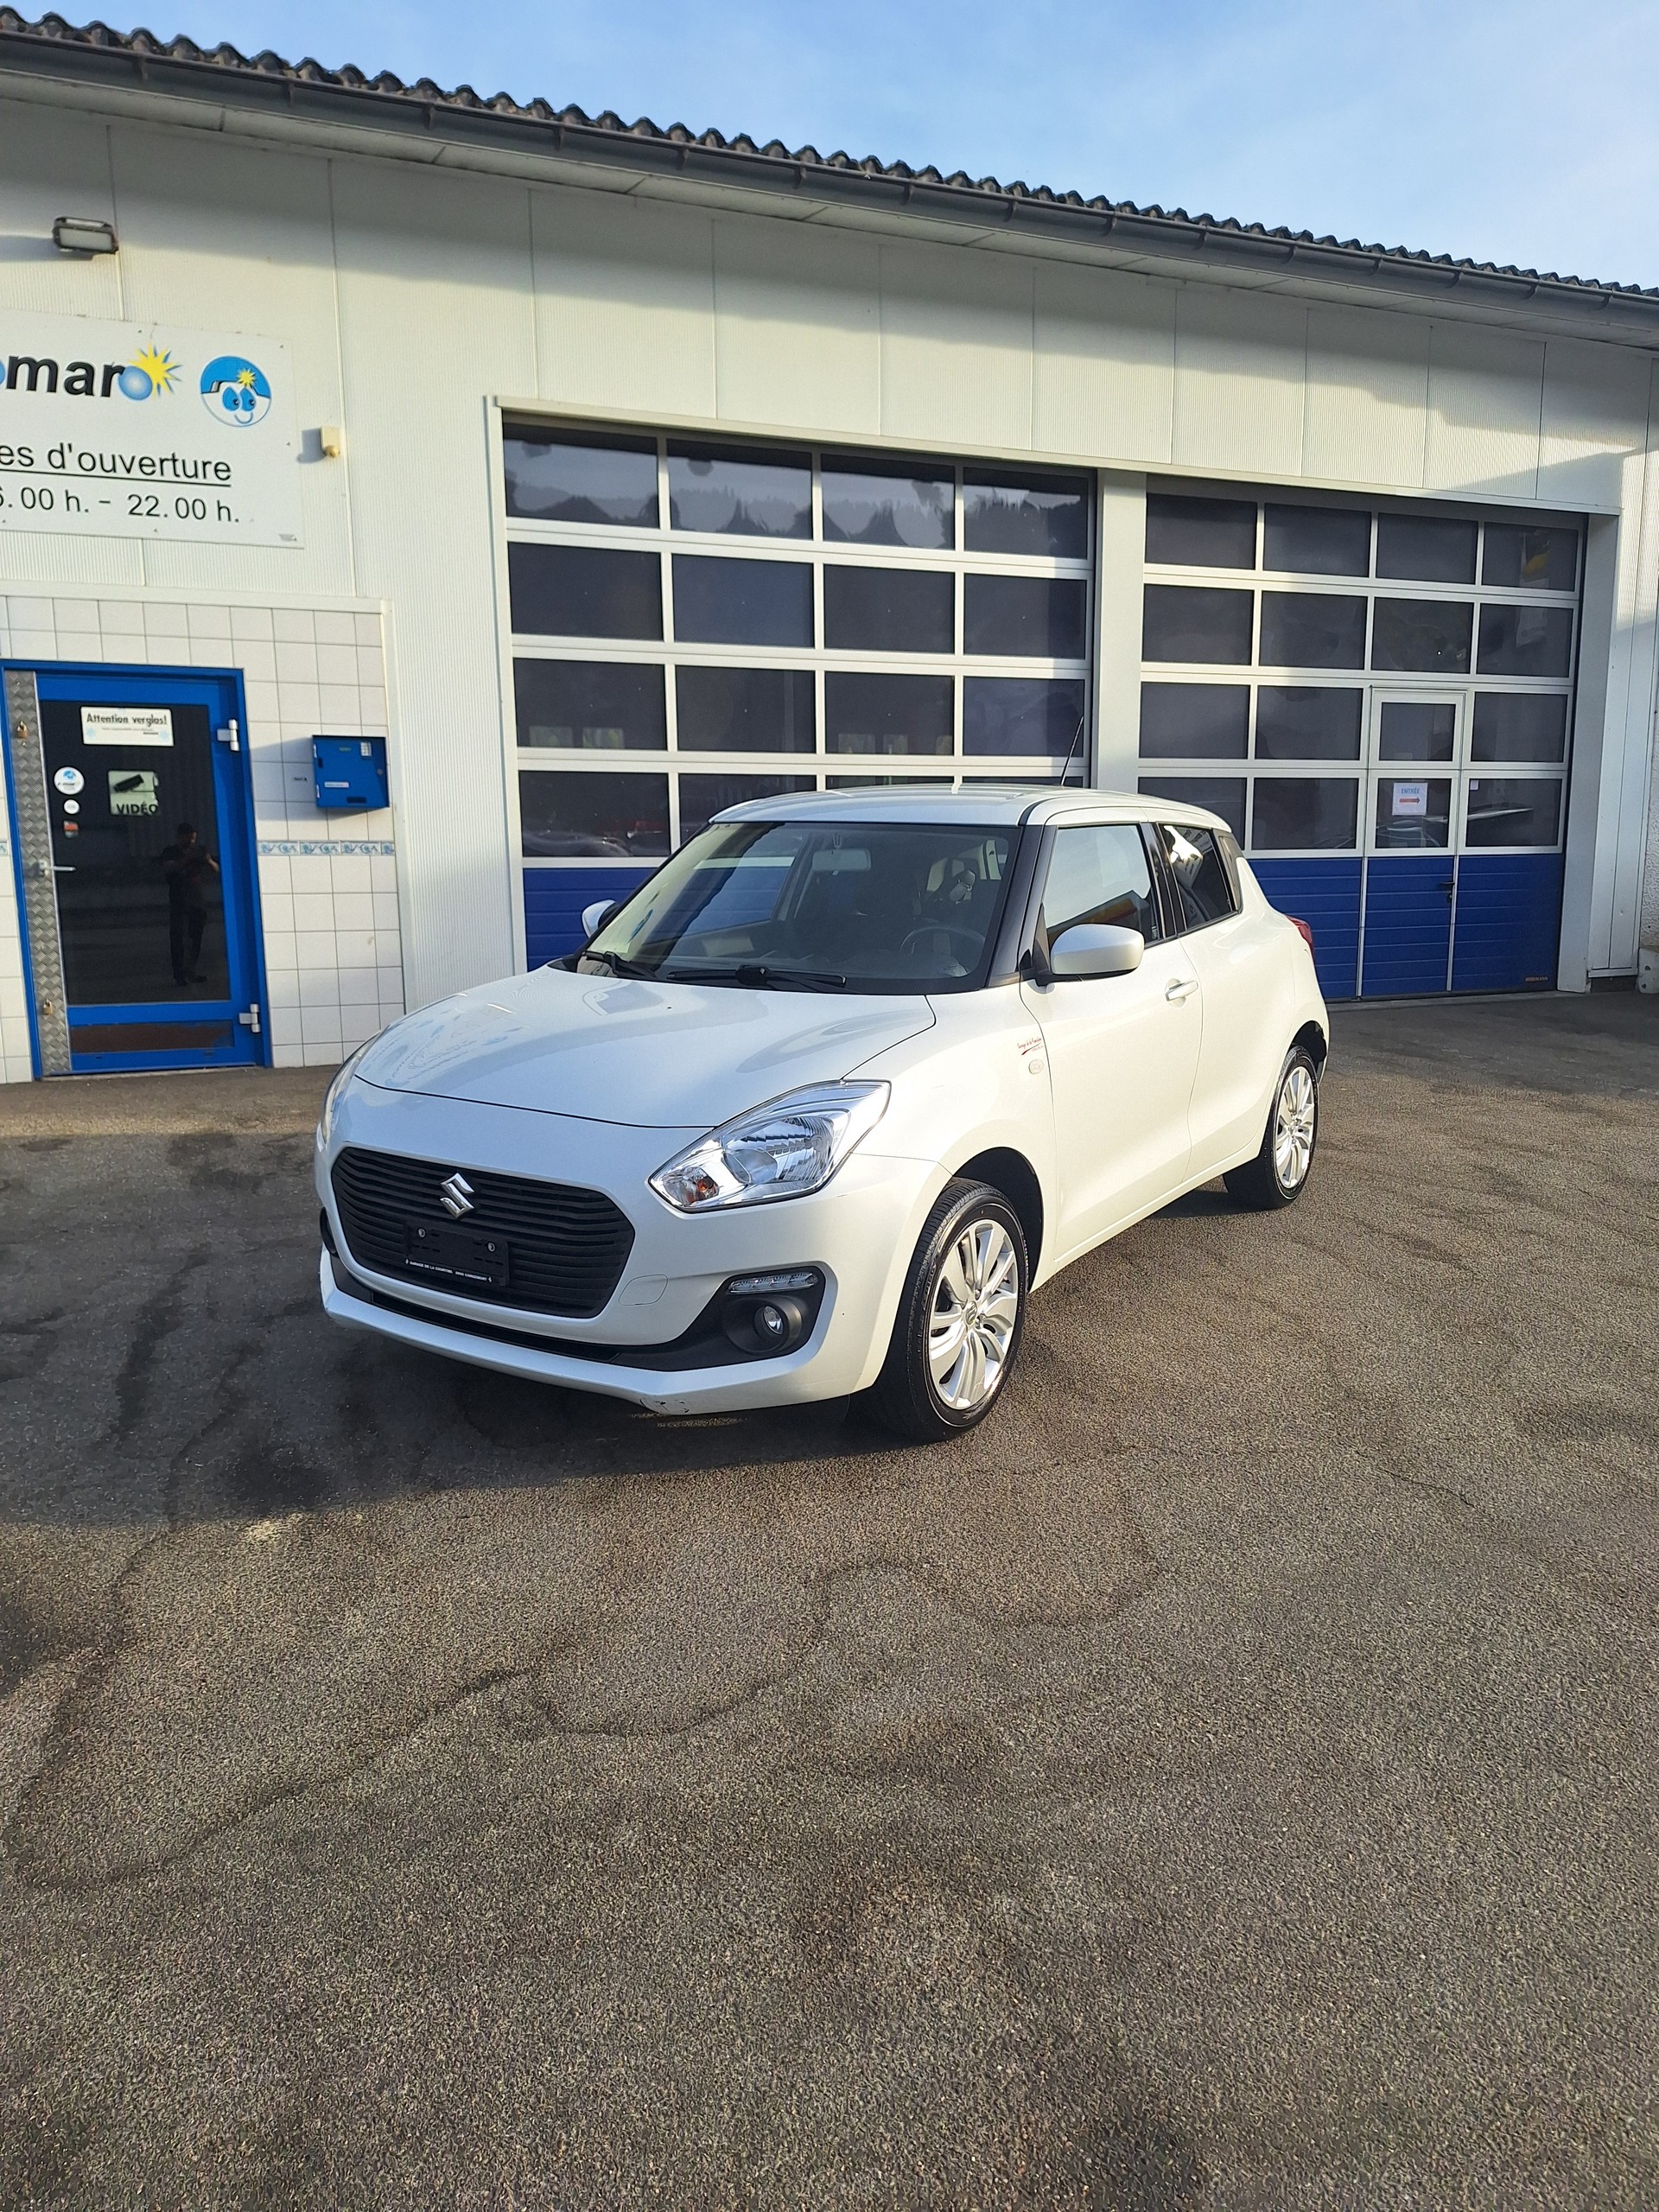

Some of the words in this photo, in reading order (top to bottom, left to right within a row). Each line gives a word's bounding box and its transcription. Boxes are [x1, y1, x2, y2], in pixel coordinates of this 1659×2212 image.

[48, 442, 232, 480] d'ouverture
[86, 713, 129, 724] Attention
[131, 714, 167, 728] verglas!
[116, 801, 158, 815] VIDÉO
